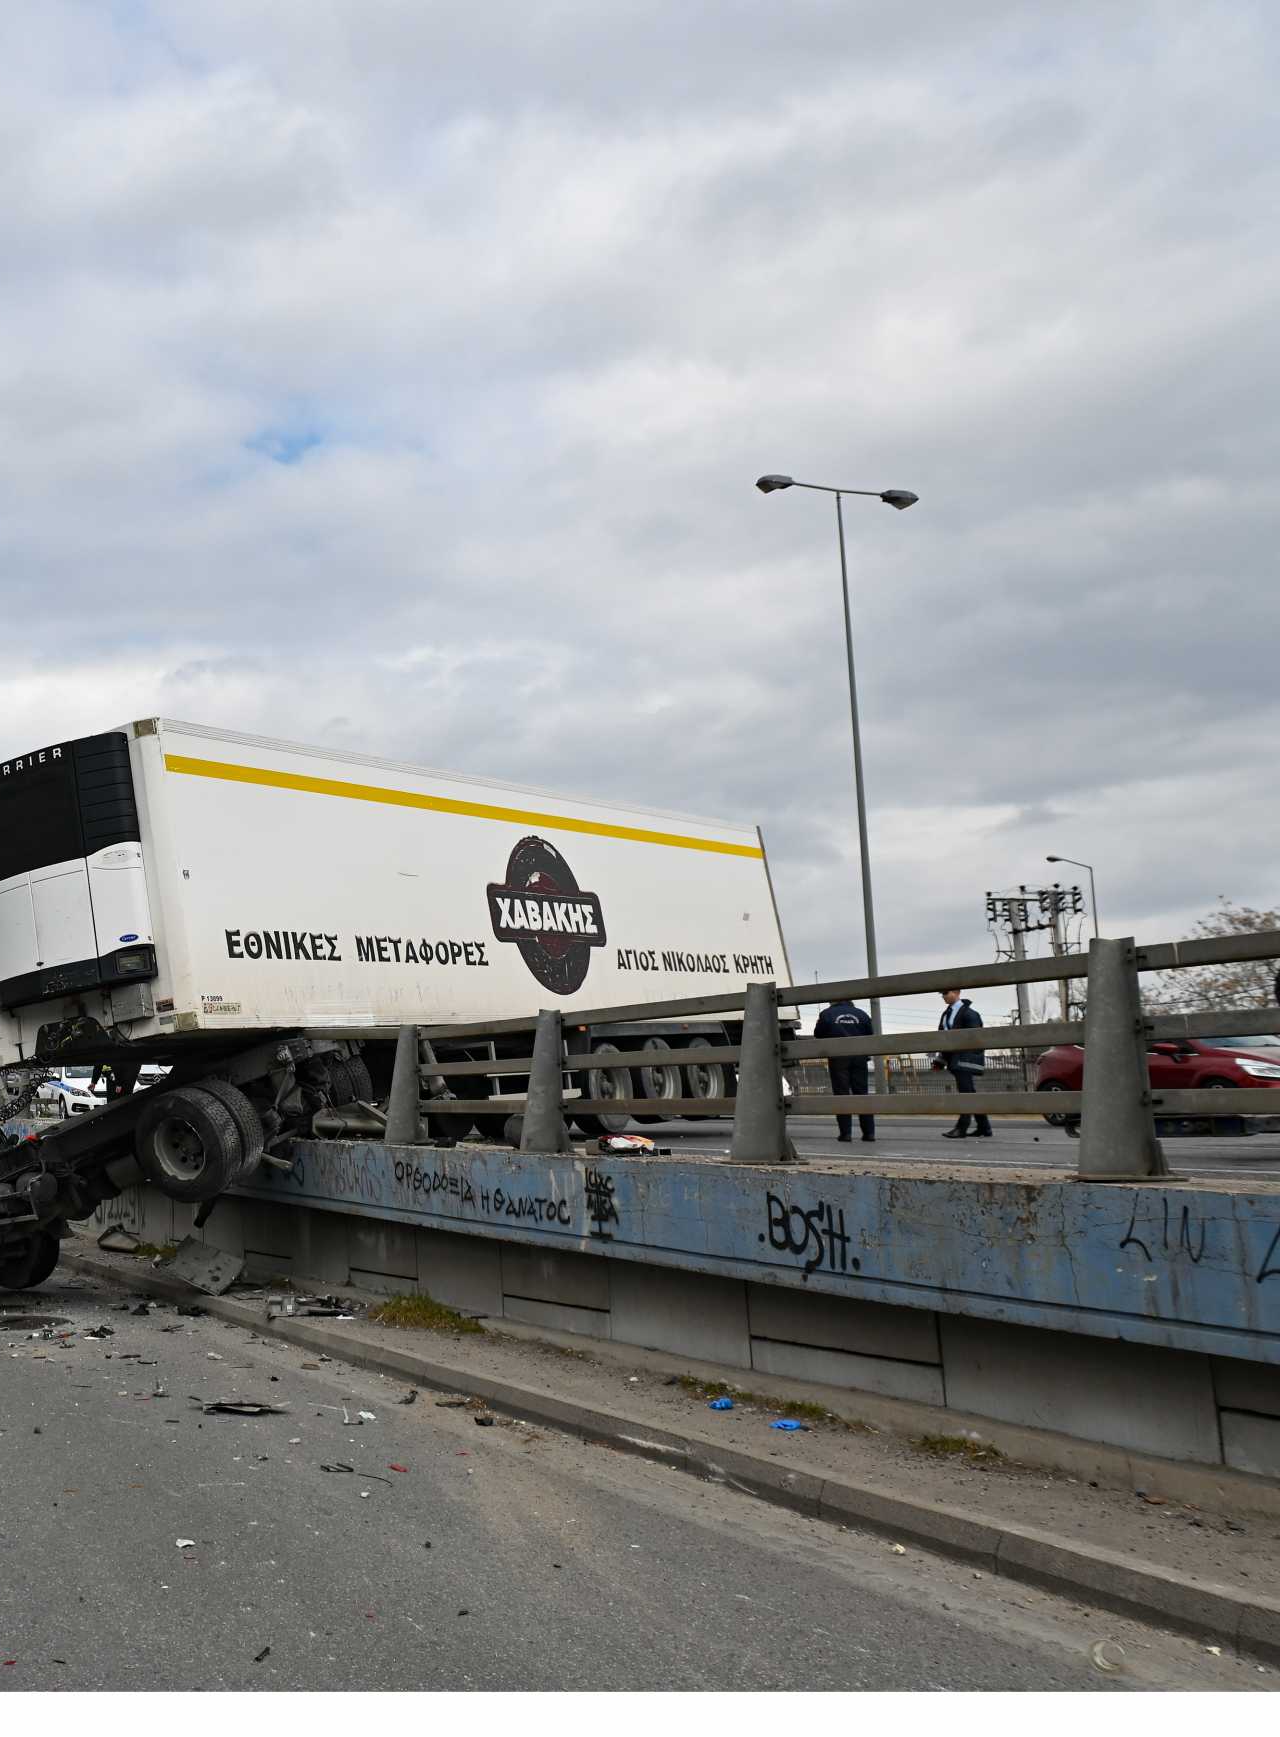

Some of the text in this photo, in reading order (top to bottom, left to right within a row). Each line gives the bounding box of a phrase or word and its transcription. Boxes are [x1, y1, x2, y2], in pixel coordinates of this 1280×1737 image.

[495, 896, 598, 934] ΧΑΒΑΚΗΣ
[224, 929, 489, 966] ΕΘΝΙΚΕΣ ΜΕΤΑΦΟΡΕΣ
[617, 949, 775, 975] ΑΓΙΟΣ ΝΙΚΟΛΑΟΣ ΚΡΗΤΗ
